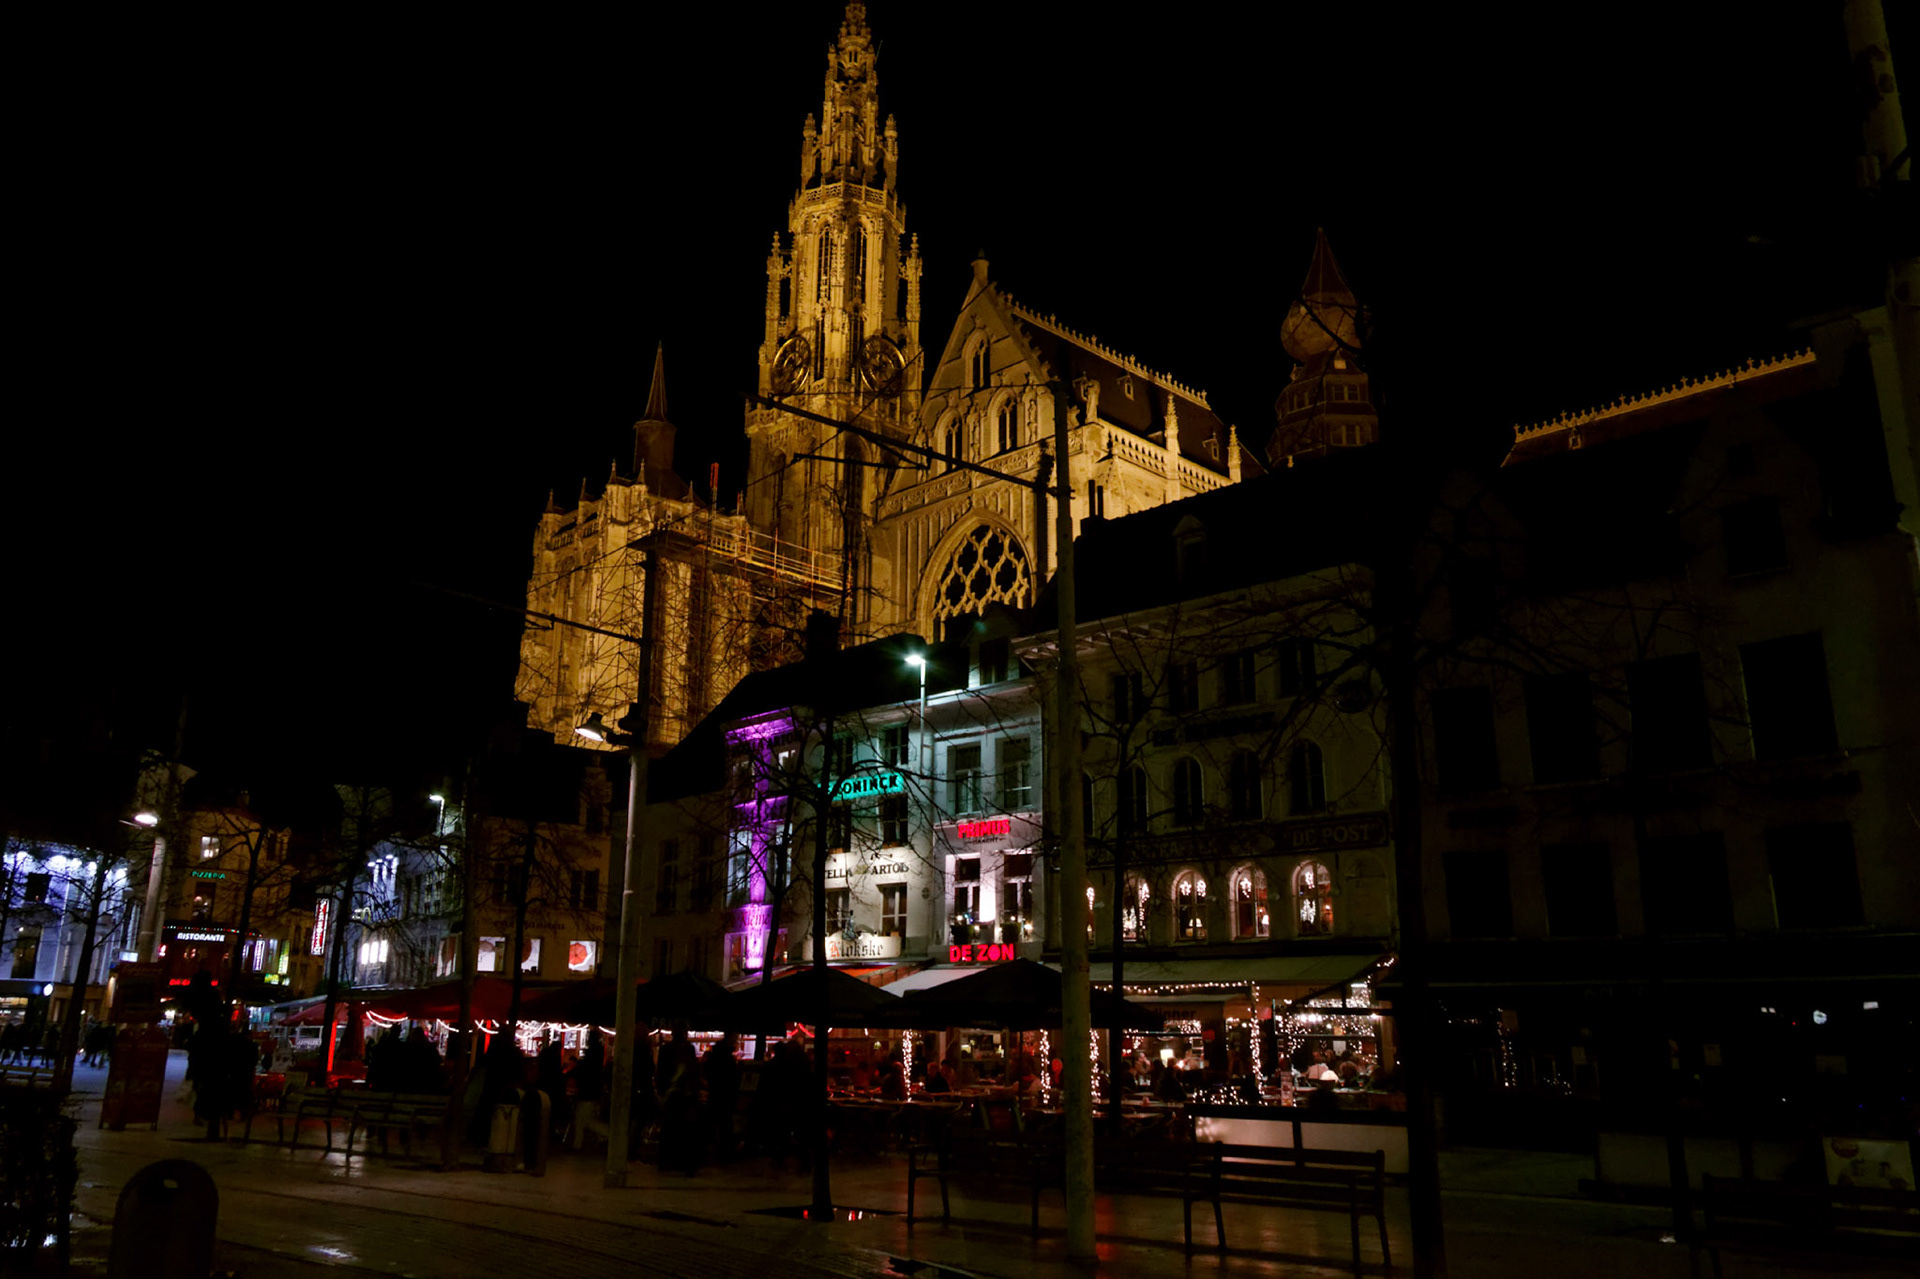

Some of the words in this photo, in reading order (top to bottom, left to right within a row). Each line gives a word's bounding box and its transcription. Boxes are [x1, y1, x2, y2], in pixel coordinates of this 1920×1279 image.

[835, 775, 897, 796] ONINCK
[958, 819, 1010, 838] PRIMUS
[177, 932, 226, 943] RISTORANTE
[829, 940, 884, 957] Klokske
[949, 944, 973, 962] DE
[976, 943, 1014, 962] ZON
